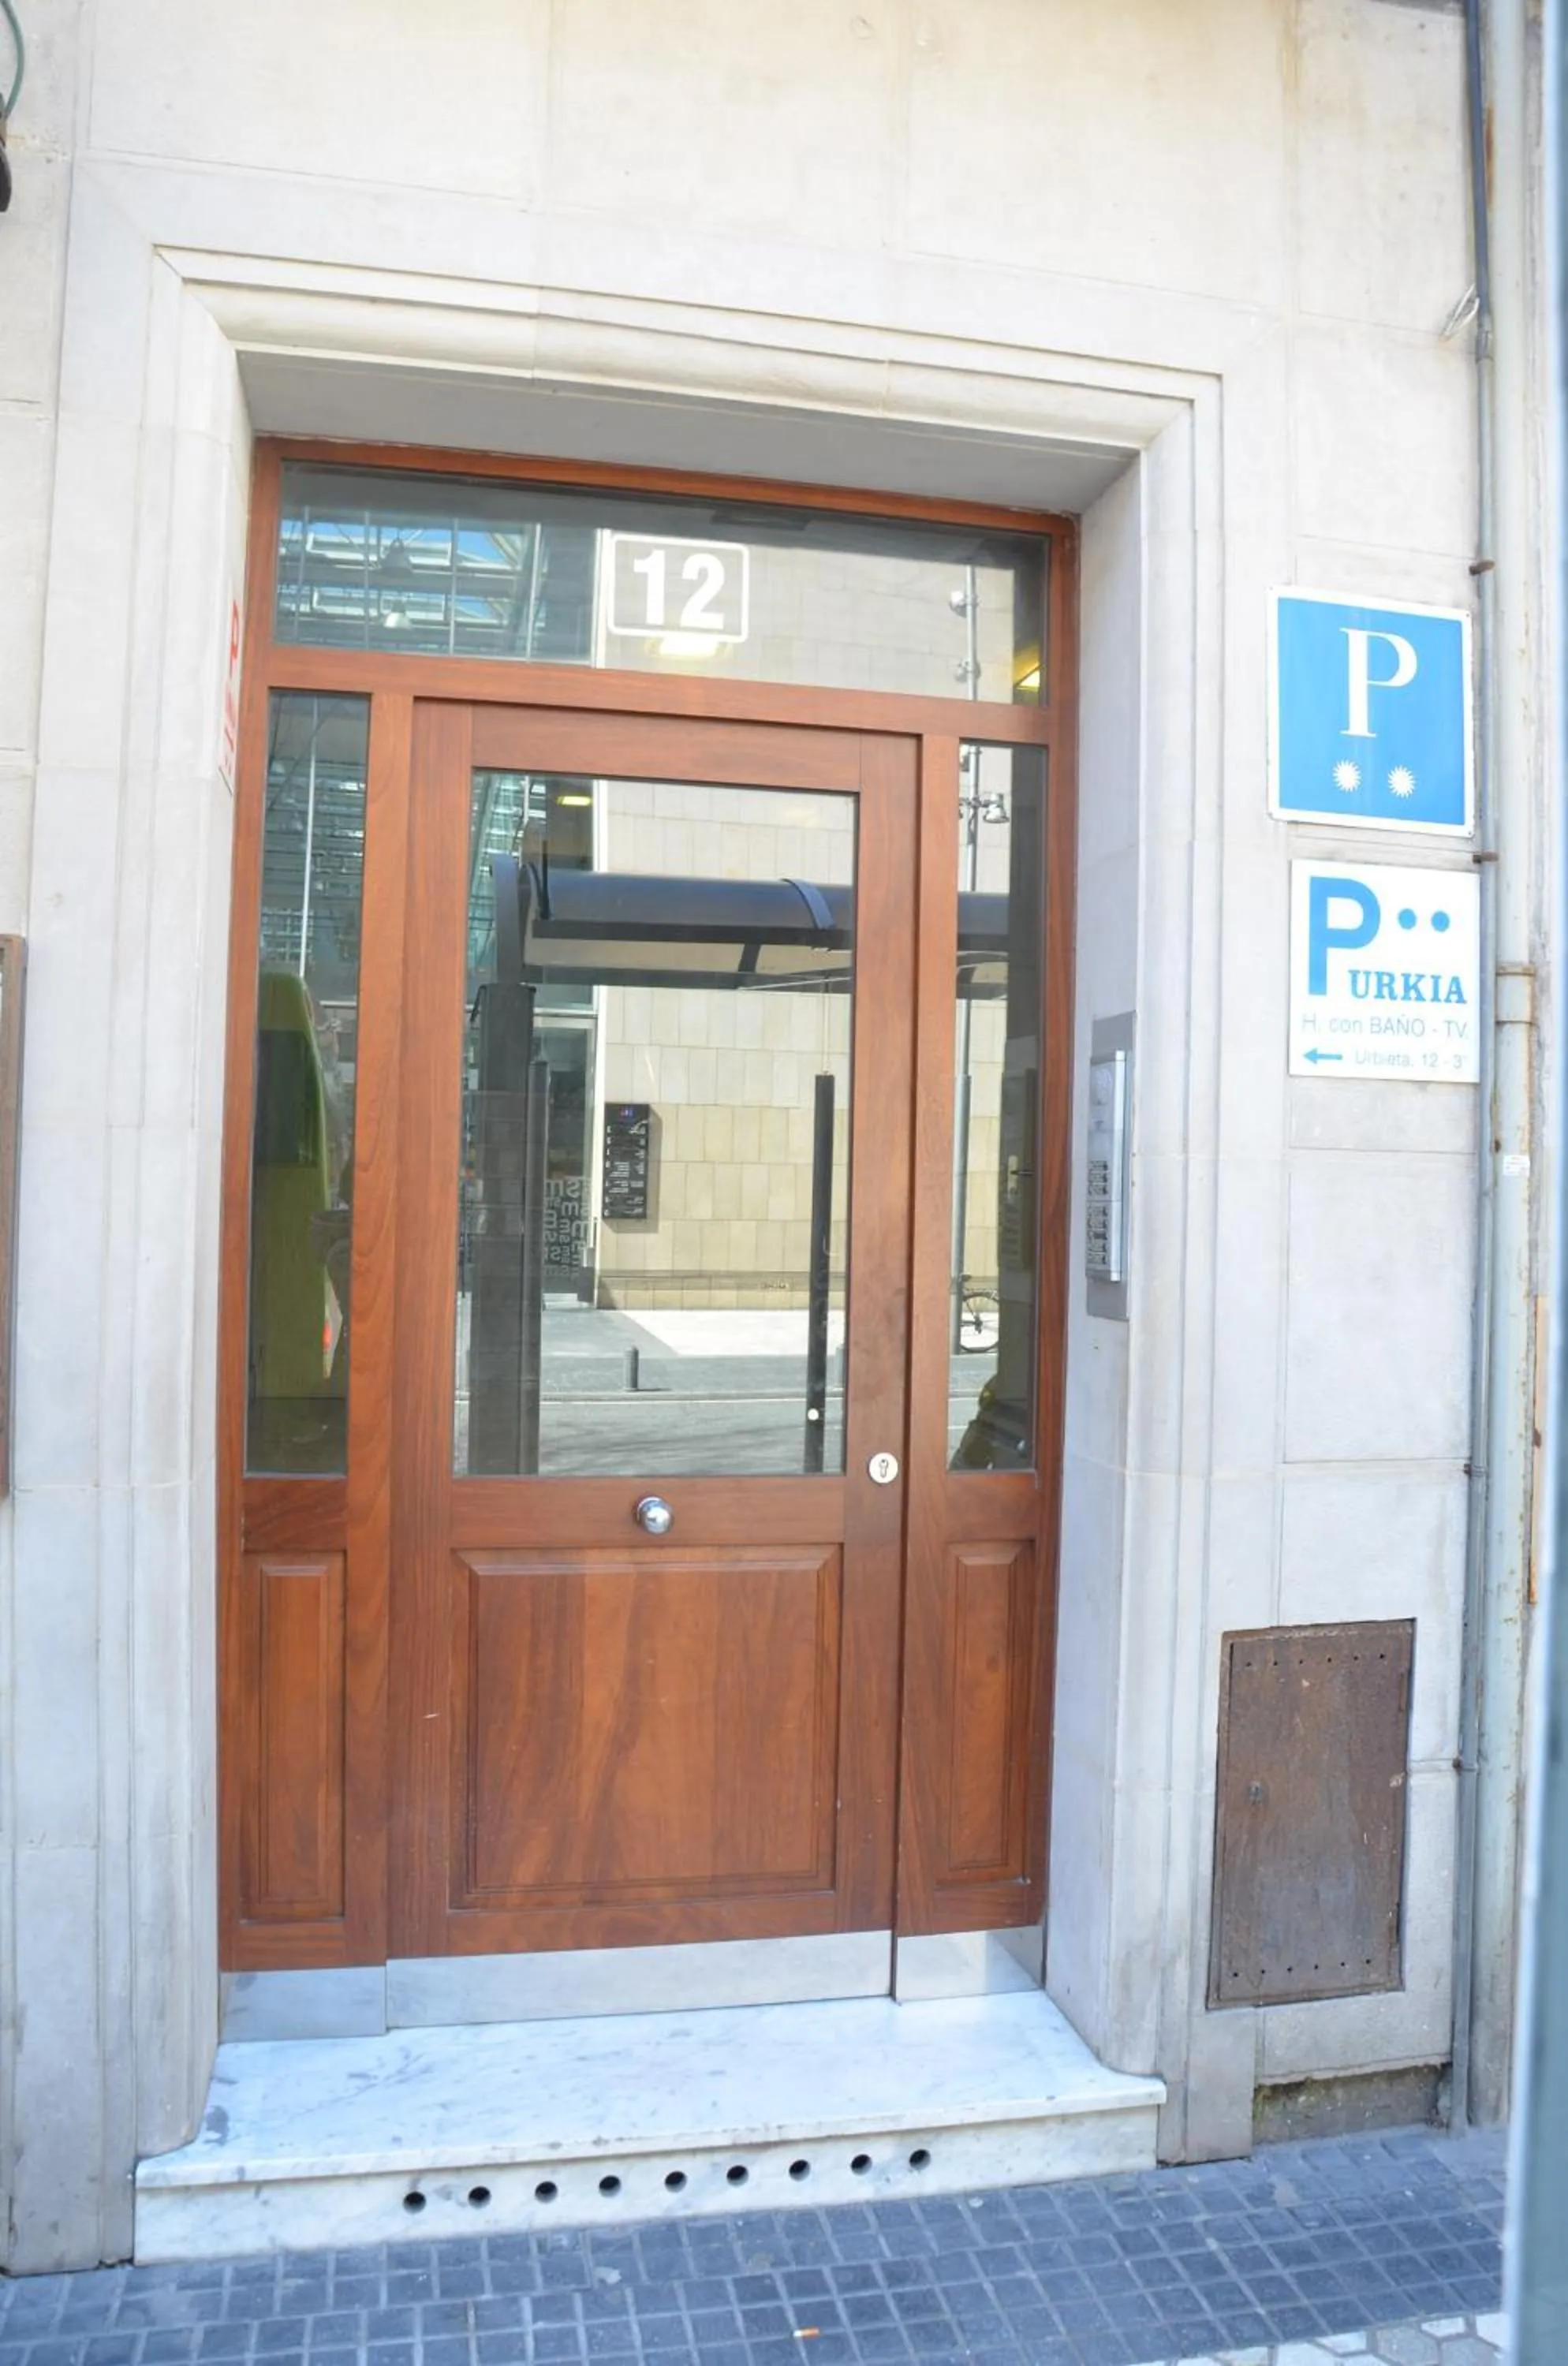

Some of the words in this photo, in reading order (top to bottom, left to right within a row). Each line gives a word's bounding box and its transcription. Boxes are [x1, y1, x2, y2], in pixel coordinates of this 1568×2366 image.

[633, 549, 725, 629] 12
[1339, 627, 1418, 737] P
[1329, 1017, 1362, 1035] con
[1370, 1013, 1424, 1037] BAÑO
